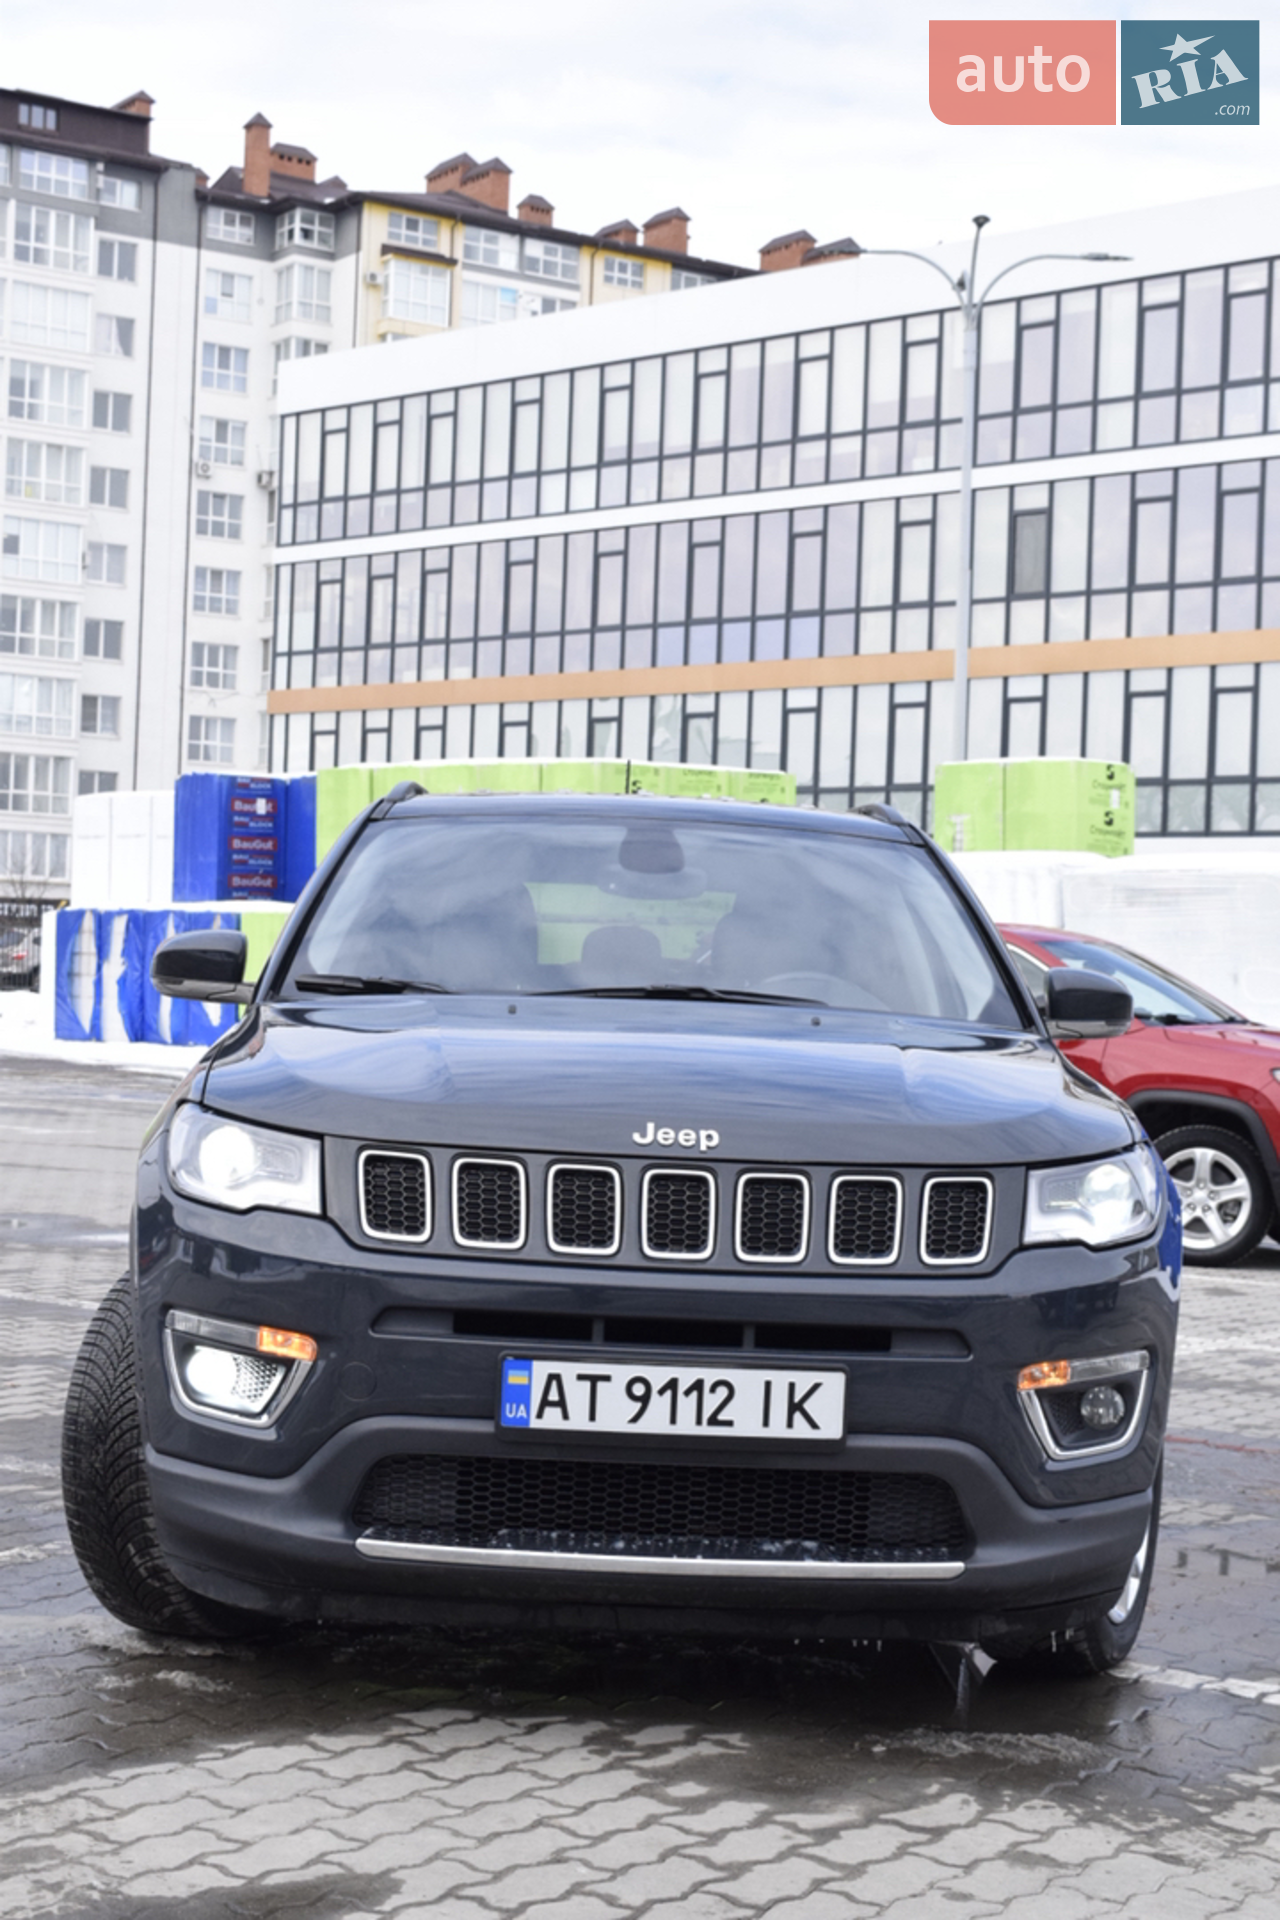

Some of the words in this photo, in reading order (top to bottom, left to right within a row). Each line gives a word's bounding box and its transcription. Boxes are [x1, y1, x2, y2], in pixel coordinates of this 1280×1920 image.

[233, 800, 273, 812] Baut
[232, 838, 273, 850] BauGut
[232, 875, 273, 887] BauGut
[632, 1121, 720, 1152] Jeep
[535, 1372, 612, 1422] AT
[625, 1375, 736, 1428] 9112
[761, 1379, 824, 1430] IK
[505, 1402, 528, 1419] UA
